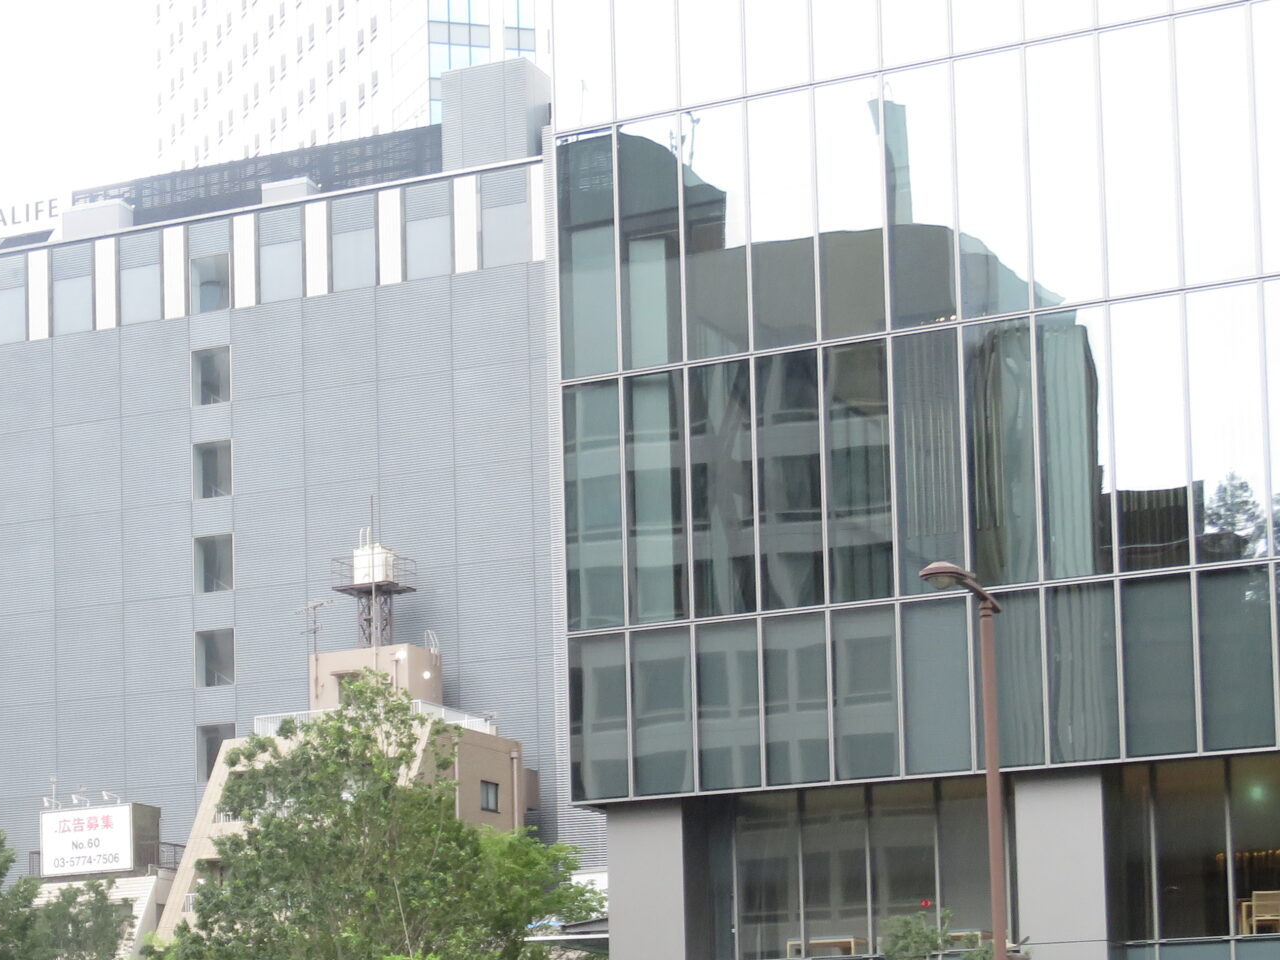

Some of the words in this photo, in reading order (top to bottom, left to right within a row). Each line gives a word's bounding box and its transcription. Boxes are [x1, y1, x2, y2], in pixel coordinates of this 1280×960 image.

[58, 814, 114, 833] 広告募集
[53, 852, 120, 869] 03-5774-7506
